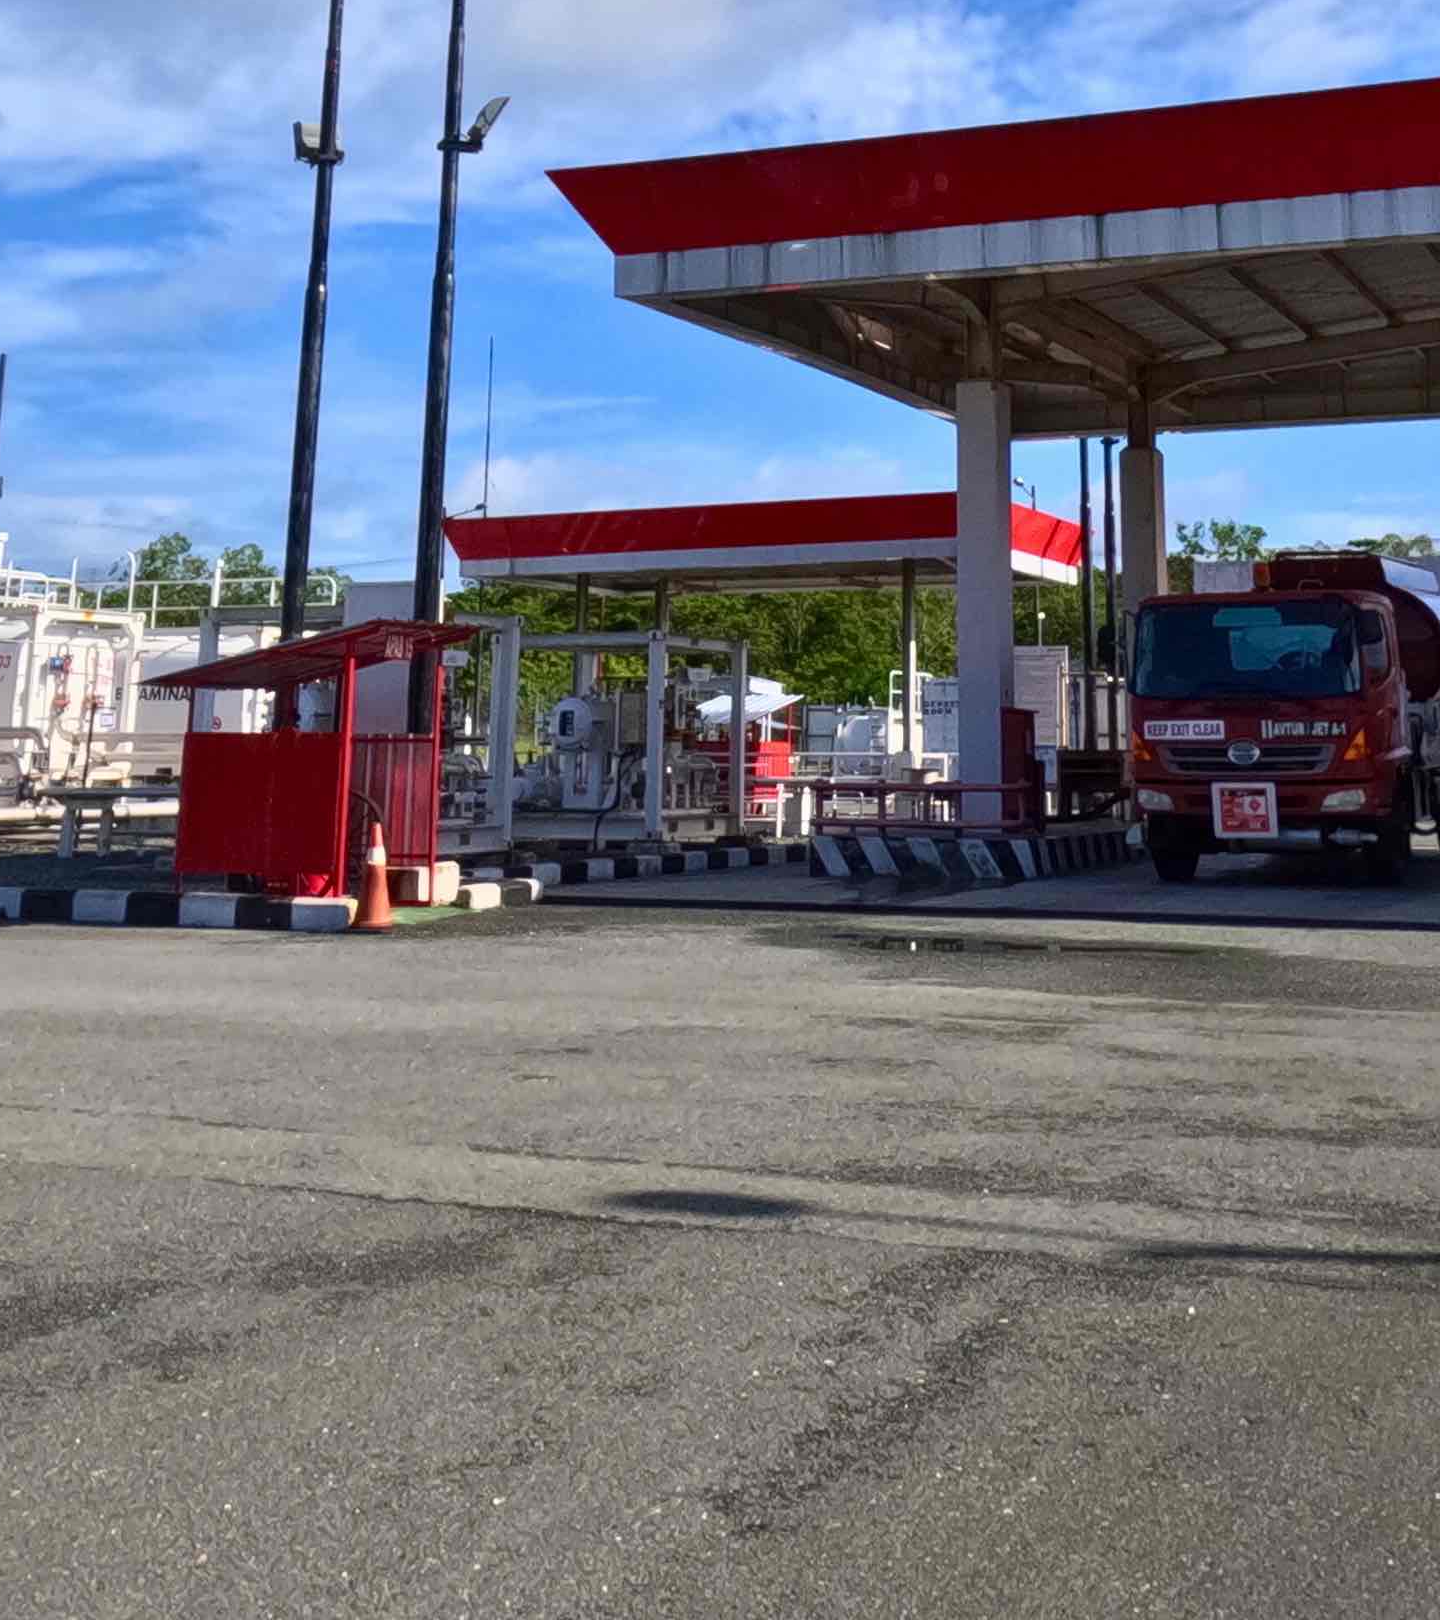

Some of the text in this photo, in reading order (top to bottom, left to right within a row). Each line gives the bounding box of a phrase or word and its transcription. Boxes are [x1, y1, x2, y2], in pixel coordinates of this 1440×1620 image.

[1146, 723, 1222, 736] KEEP EXIT CLEAR
